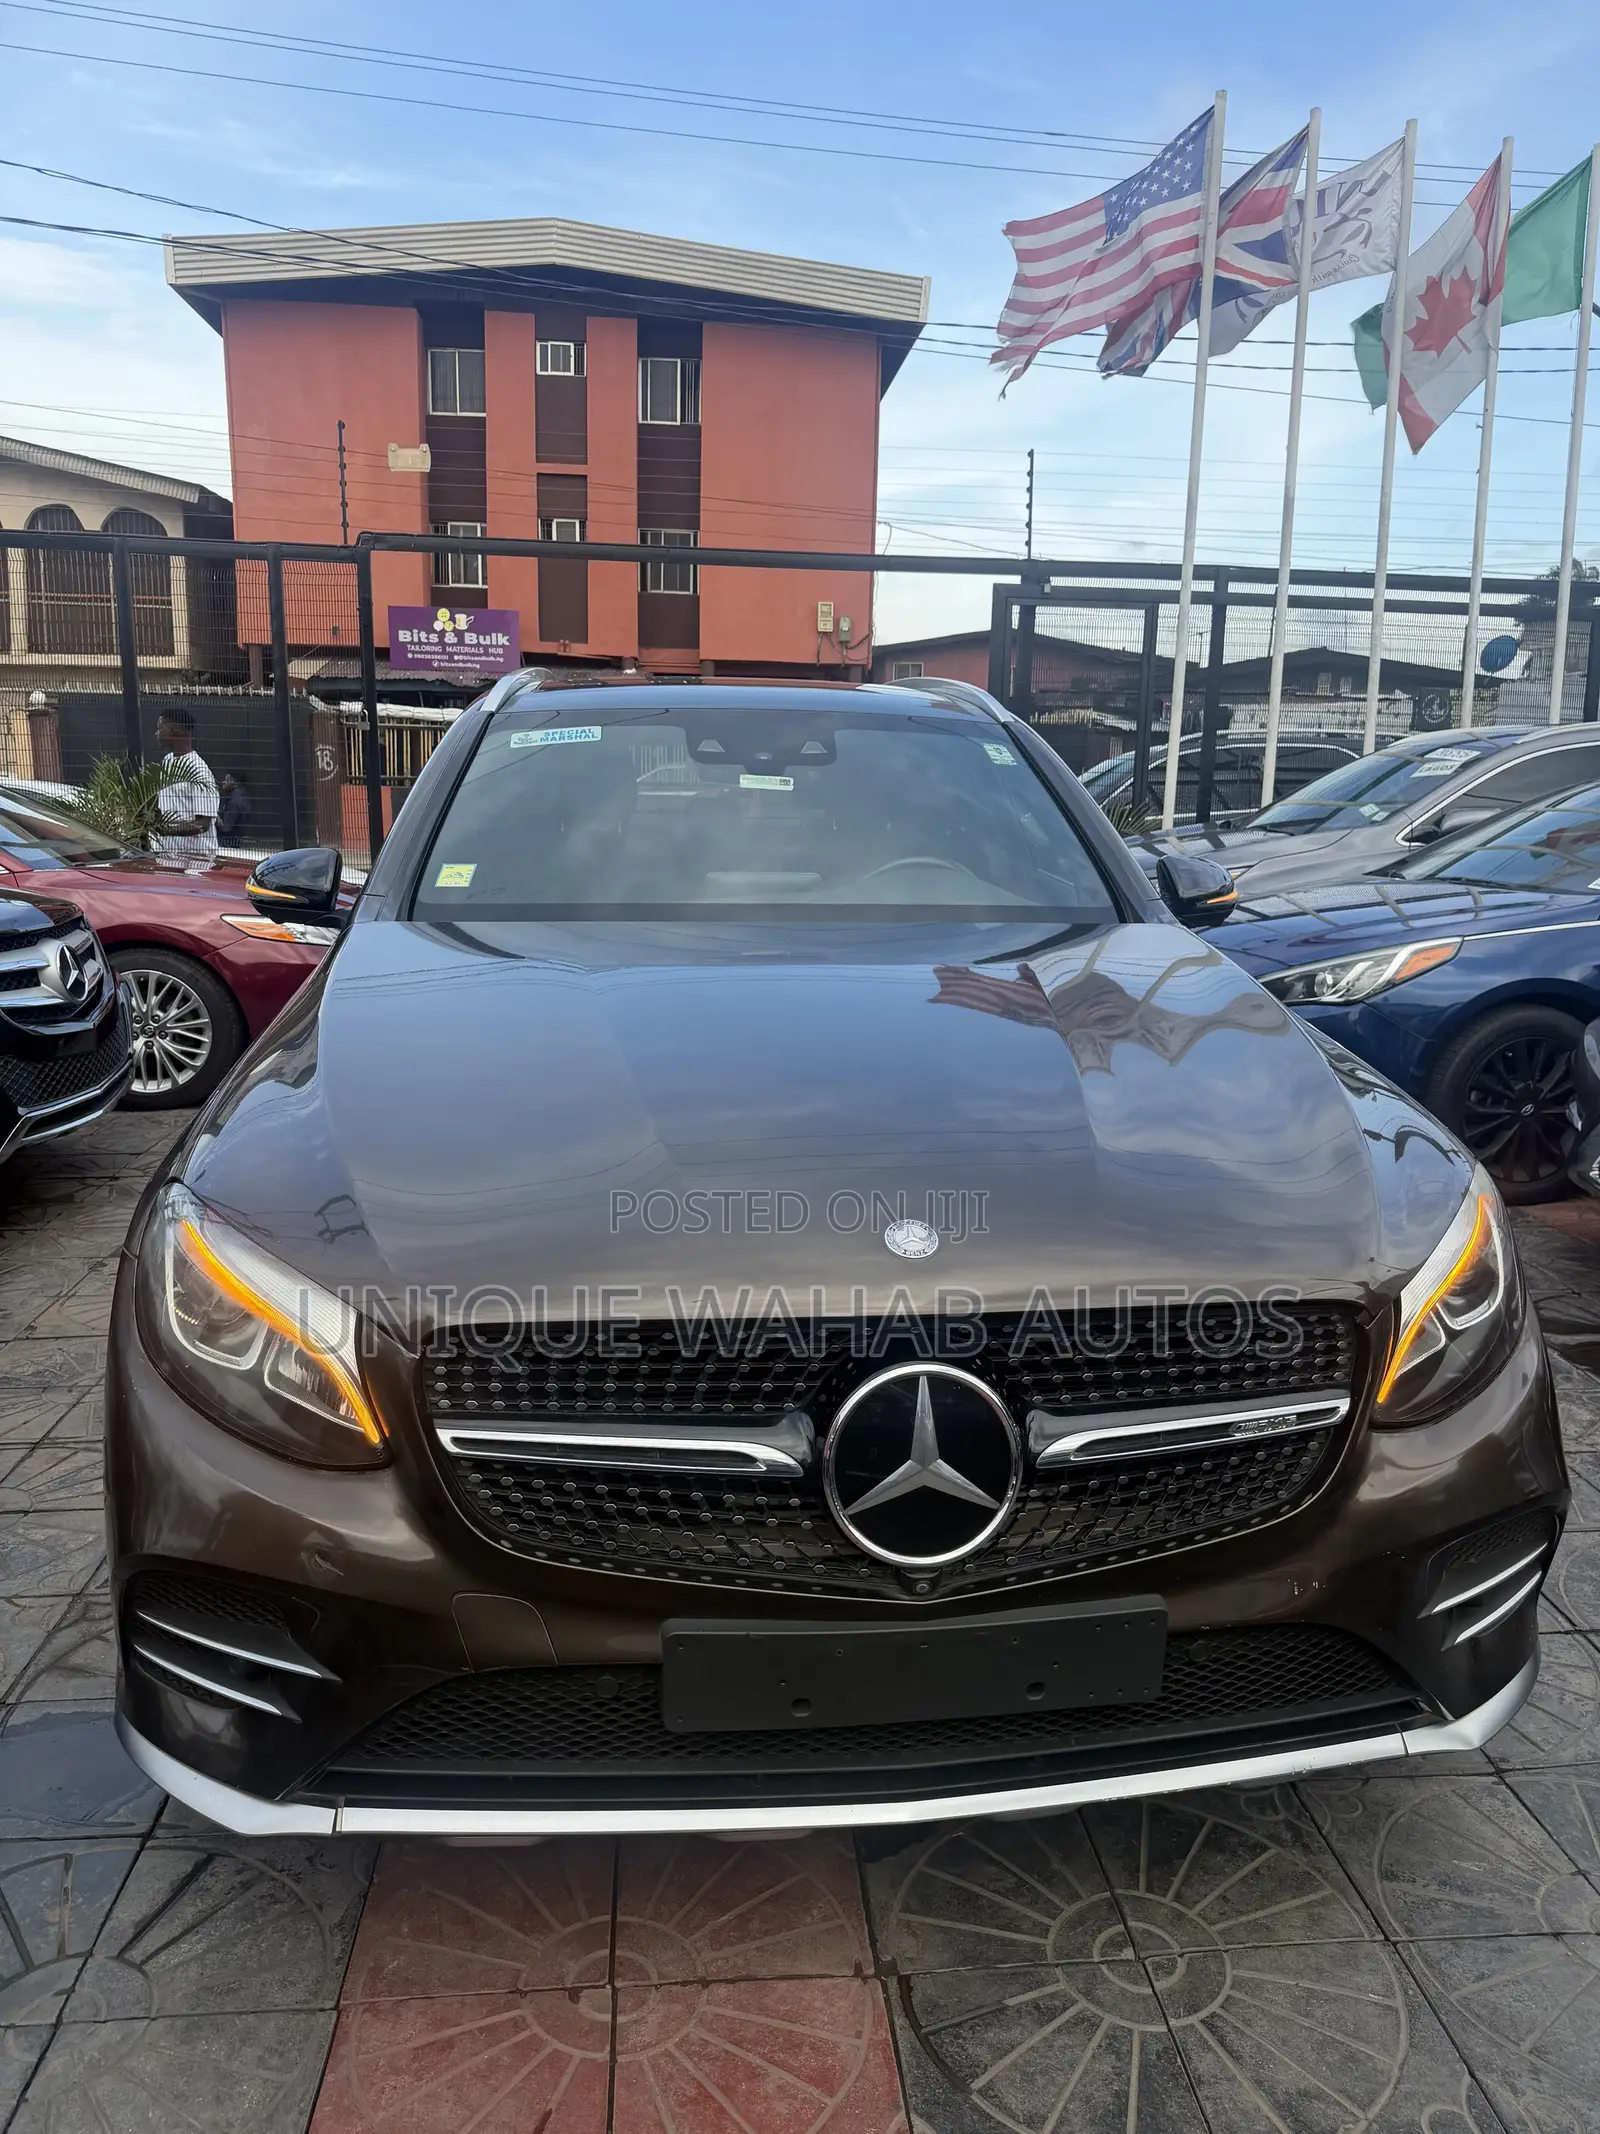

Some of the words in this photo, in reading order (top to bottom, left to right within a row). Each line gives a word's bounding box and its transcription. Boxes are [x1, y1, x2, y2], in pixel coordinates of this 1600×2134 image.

[398, 629, 439, 643] Bits
[444, 632, 458, 644] &
[465, 632, 510, 646] Bulk
[406, 644, 442, 652] TAILORING
[446, 646, 484, 654] MATERIALS
[488, 647, 504, 655] HUB
[540, 733, 598, 743] MARSHAL
[544, 728, 595, 737] SPECIAL
[316, 750, 334, 771] 18
